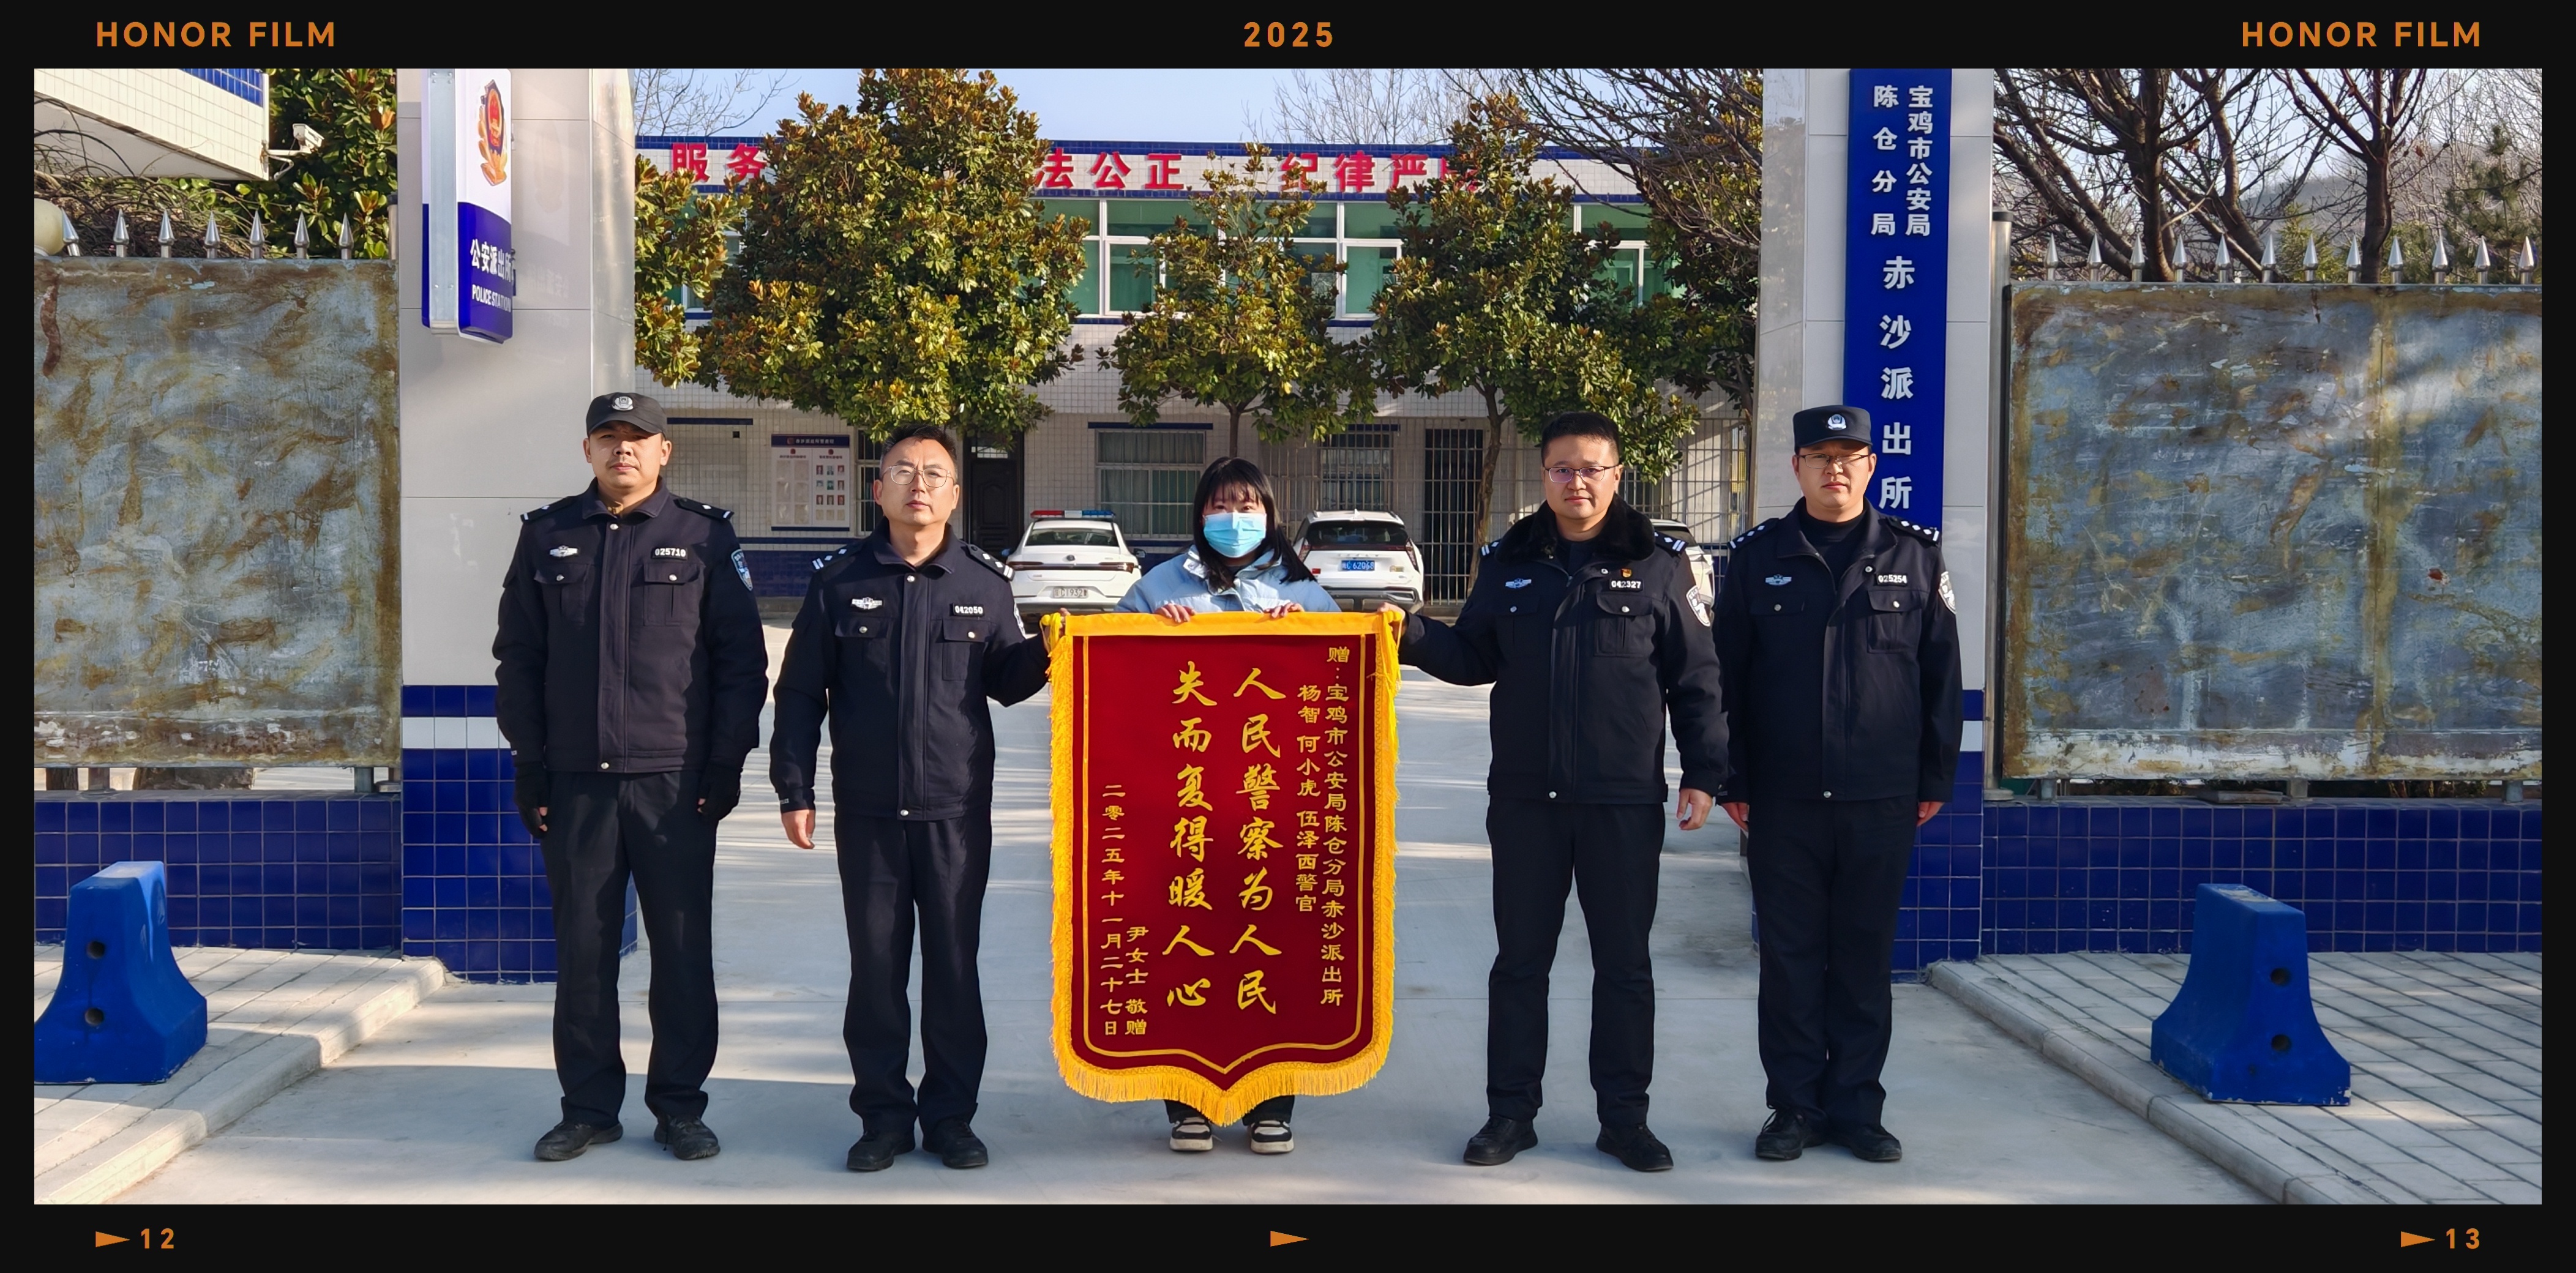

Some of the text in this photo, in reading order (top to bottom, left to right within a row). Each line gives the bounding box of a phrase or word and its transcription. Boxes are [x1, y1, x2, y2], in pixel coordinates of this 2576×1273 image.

[1871, 85, 1898, 236] 陈仓分局
[1906, 85, 1933, 236] 宝鸡市公安局
[472, 285, 511, 313] POLICE STATION
[1879, 256, 1915, 509] 赤沙派出所
[654, 548, 686, 557] 025710
[1878, 575, 1908, 584] 025254
[1162, 660, 1218, 1007] 失而复得暖人心
[1229, 668, 1286, 1015] 人民警察为人民
[1295, 684, 1322, 913] 杨智 何小虎 伍泽西警官
[1100, 785, 1126, 1036] 二零二五年十一月二十七日
[1125, 926, 1149, 1035] 尹女士 敬赠
